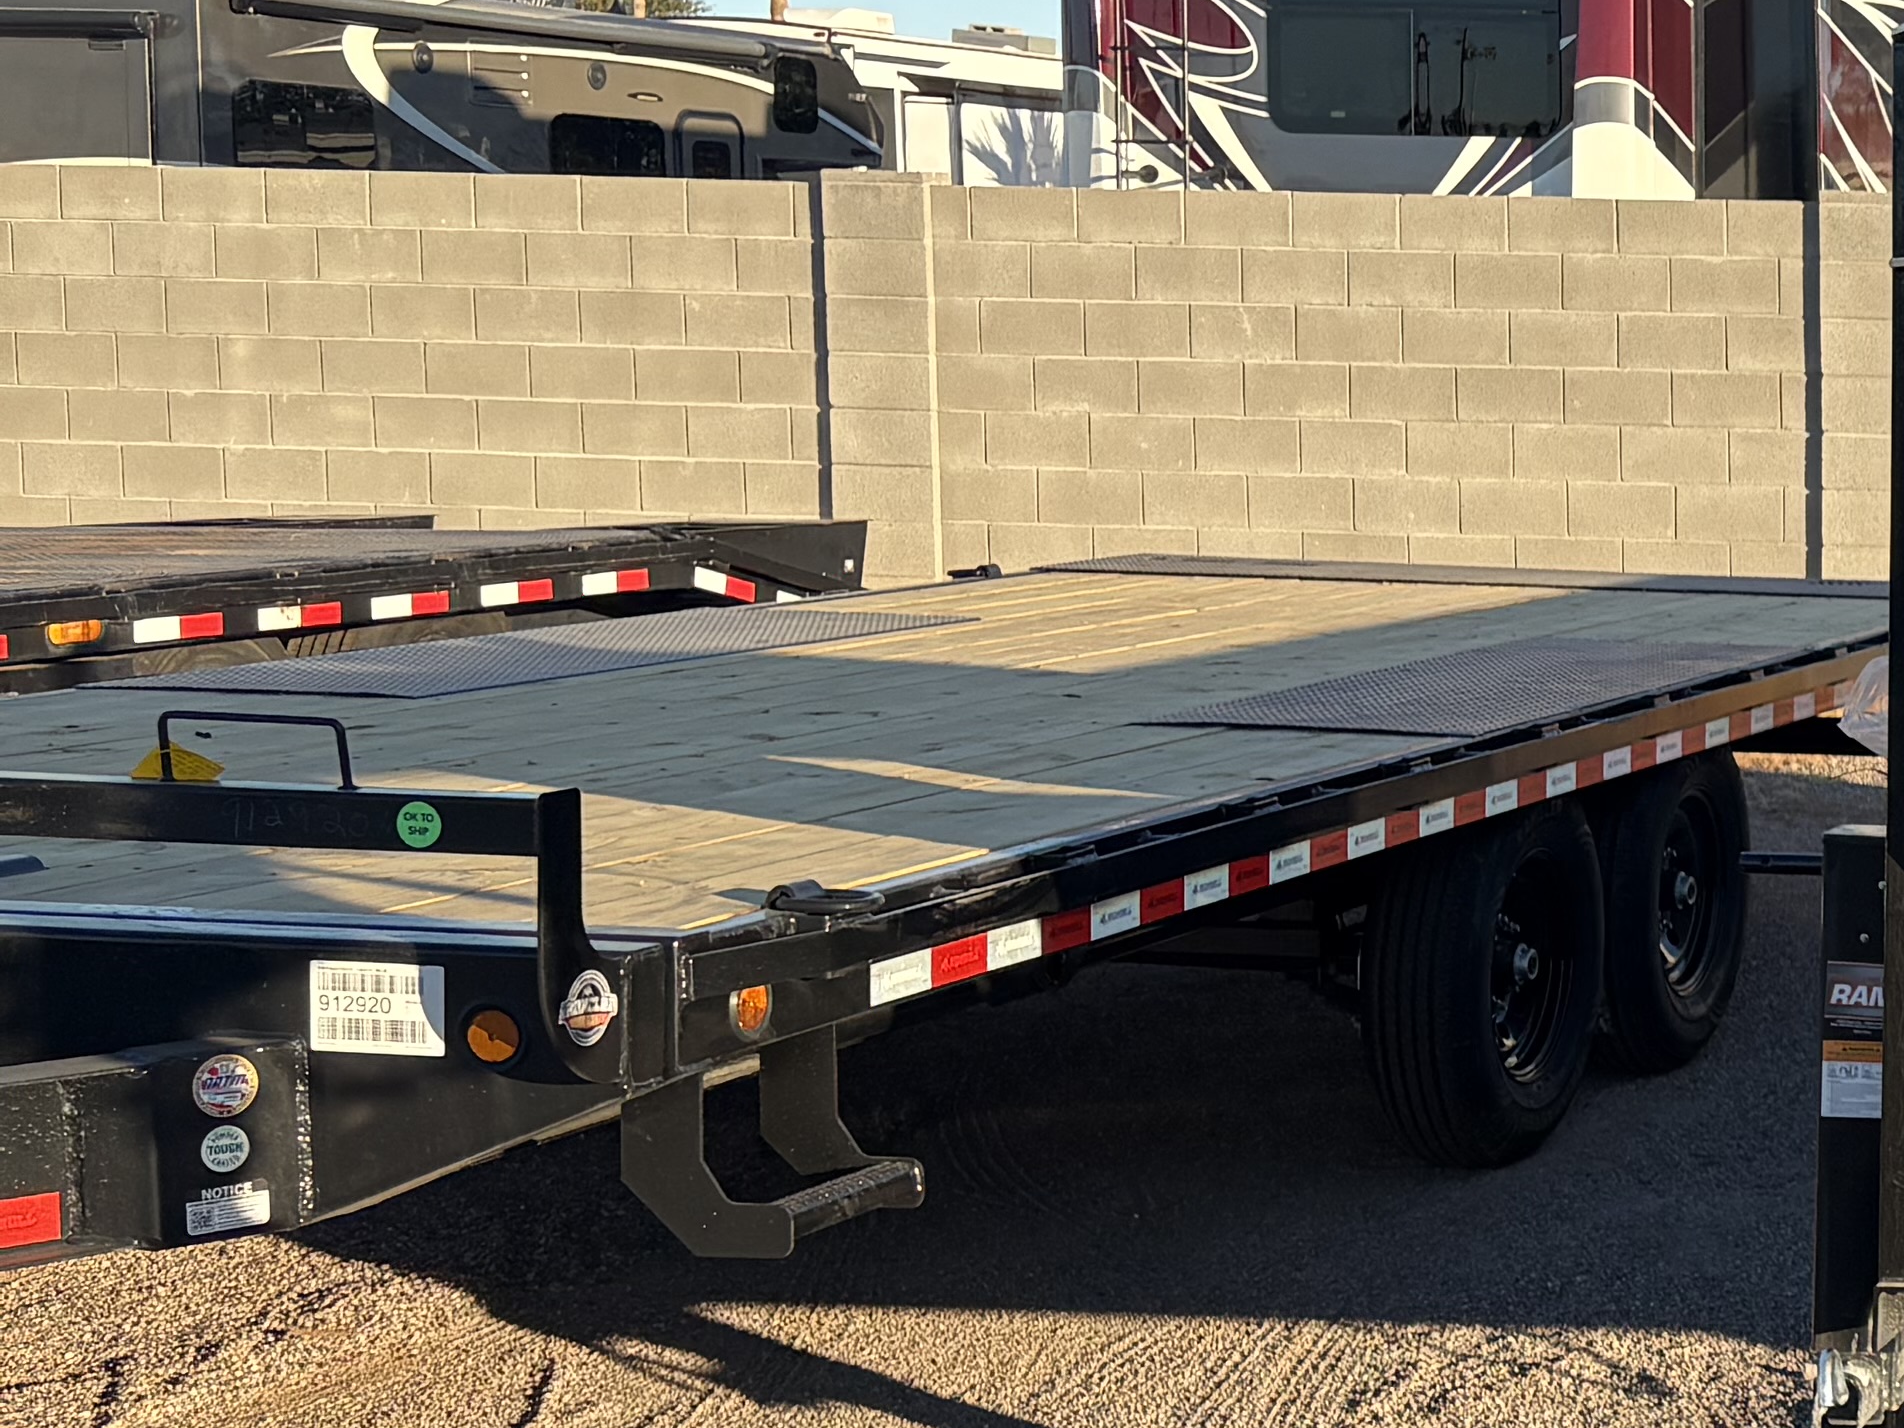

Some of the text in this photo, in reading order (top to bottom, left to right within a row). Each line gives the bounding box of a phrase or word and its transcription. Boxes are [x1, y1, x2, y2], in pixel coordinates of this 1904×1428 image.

[403, 811, 434, 823] OK TO
[408, 825, 429, 836] SHIP
[319, 994, 392, 1014] 912920
[201, 1181, 253, 1201] NOTICE
